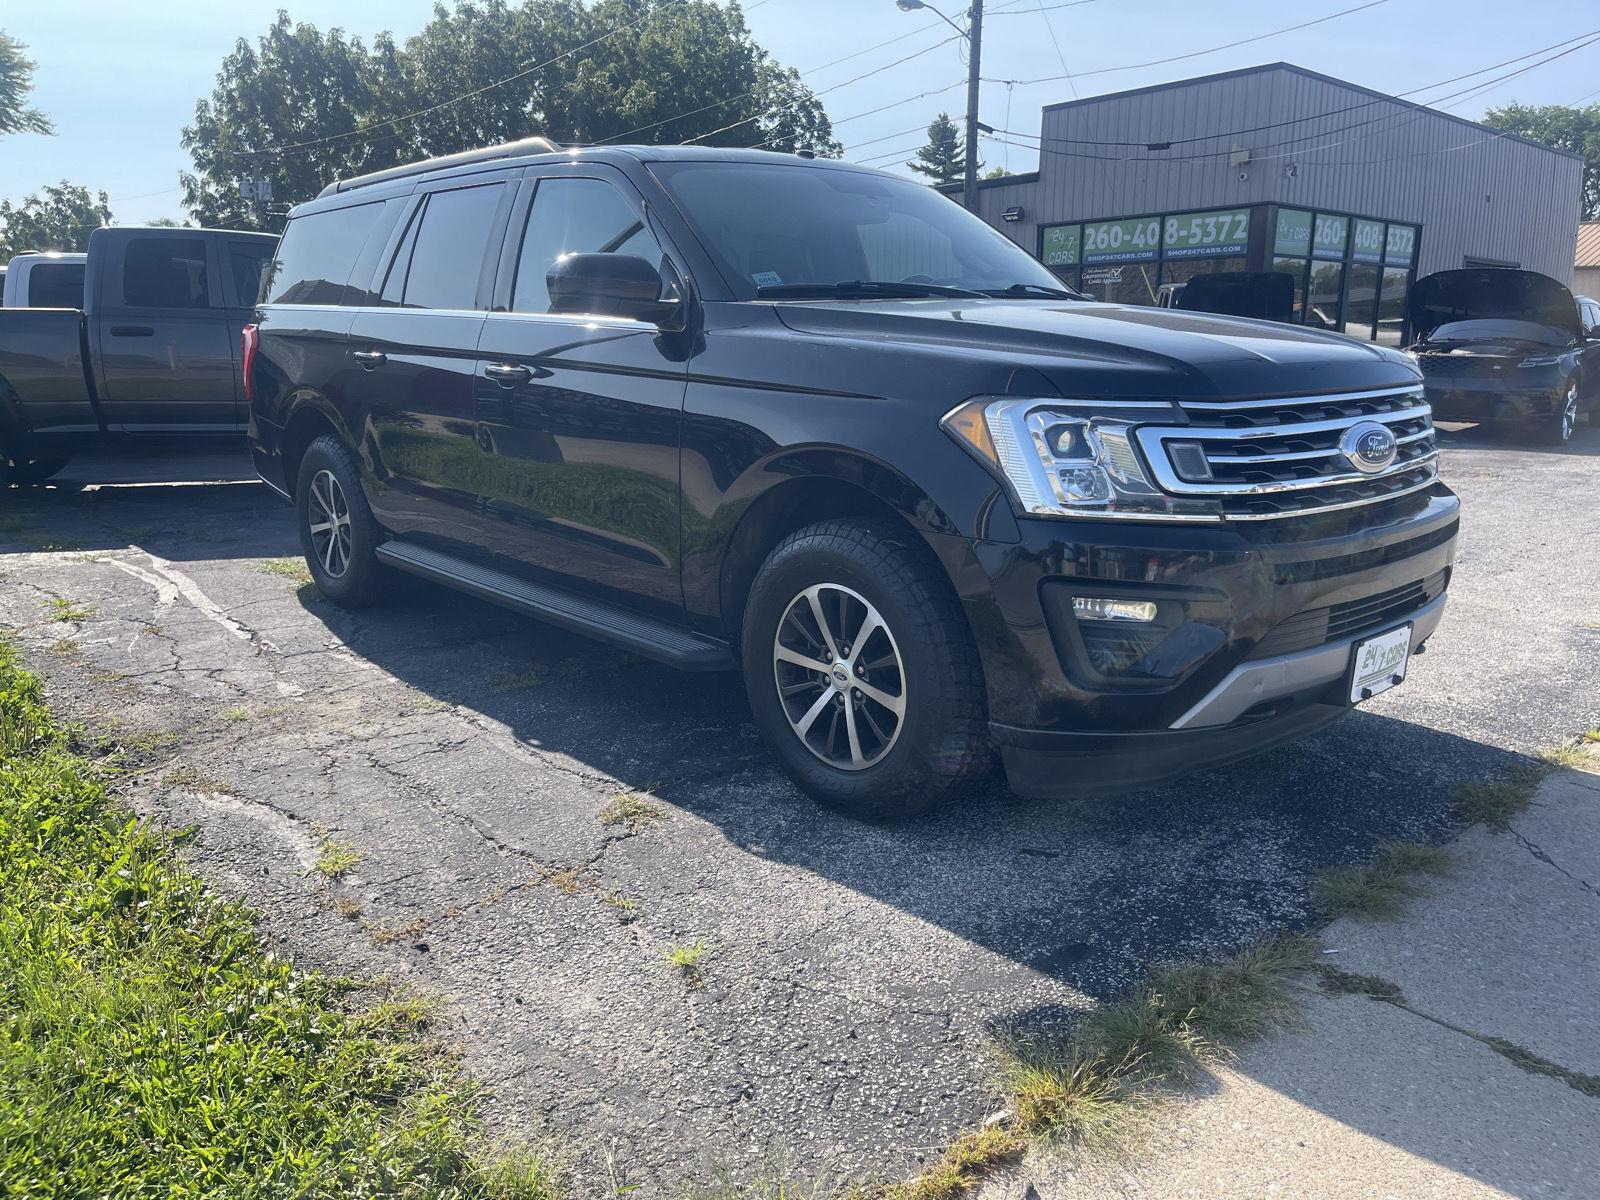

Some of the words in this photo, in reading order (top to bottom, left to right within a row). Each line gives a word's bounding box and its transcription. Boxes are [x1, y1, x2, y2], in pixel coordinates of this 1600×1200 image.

[1048, 250, 1075, 265] CARS
[1087, 251, 1153, 262] SHOP247CARS.COM
[1168, 246, 1241, 257] SHOP247CARS.COM
[1367, 435, 1390, 458] Ford
